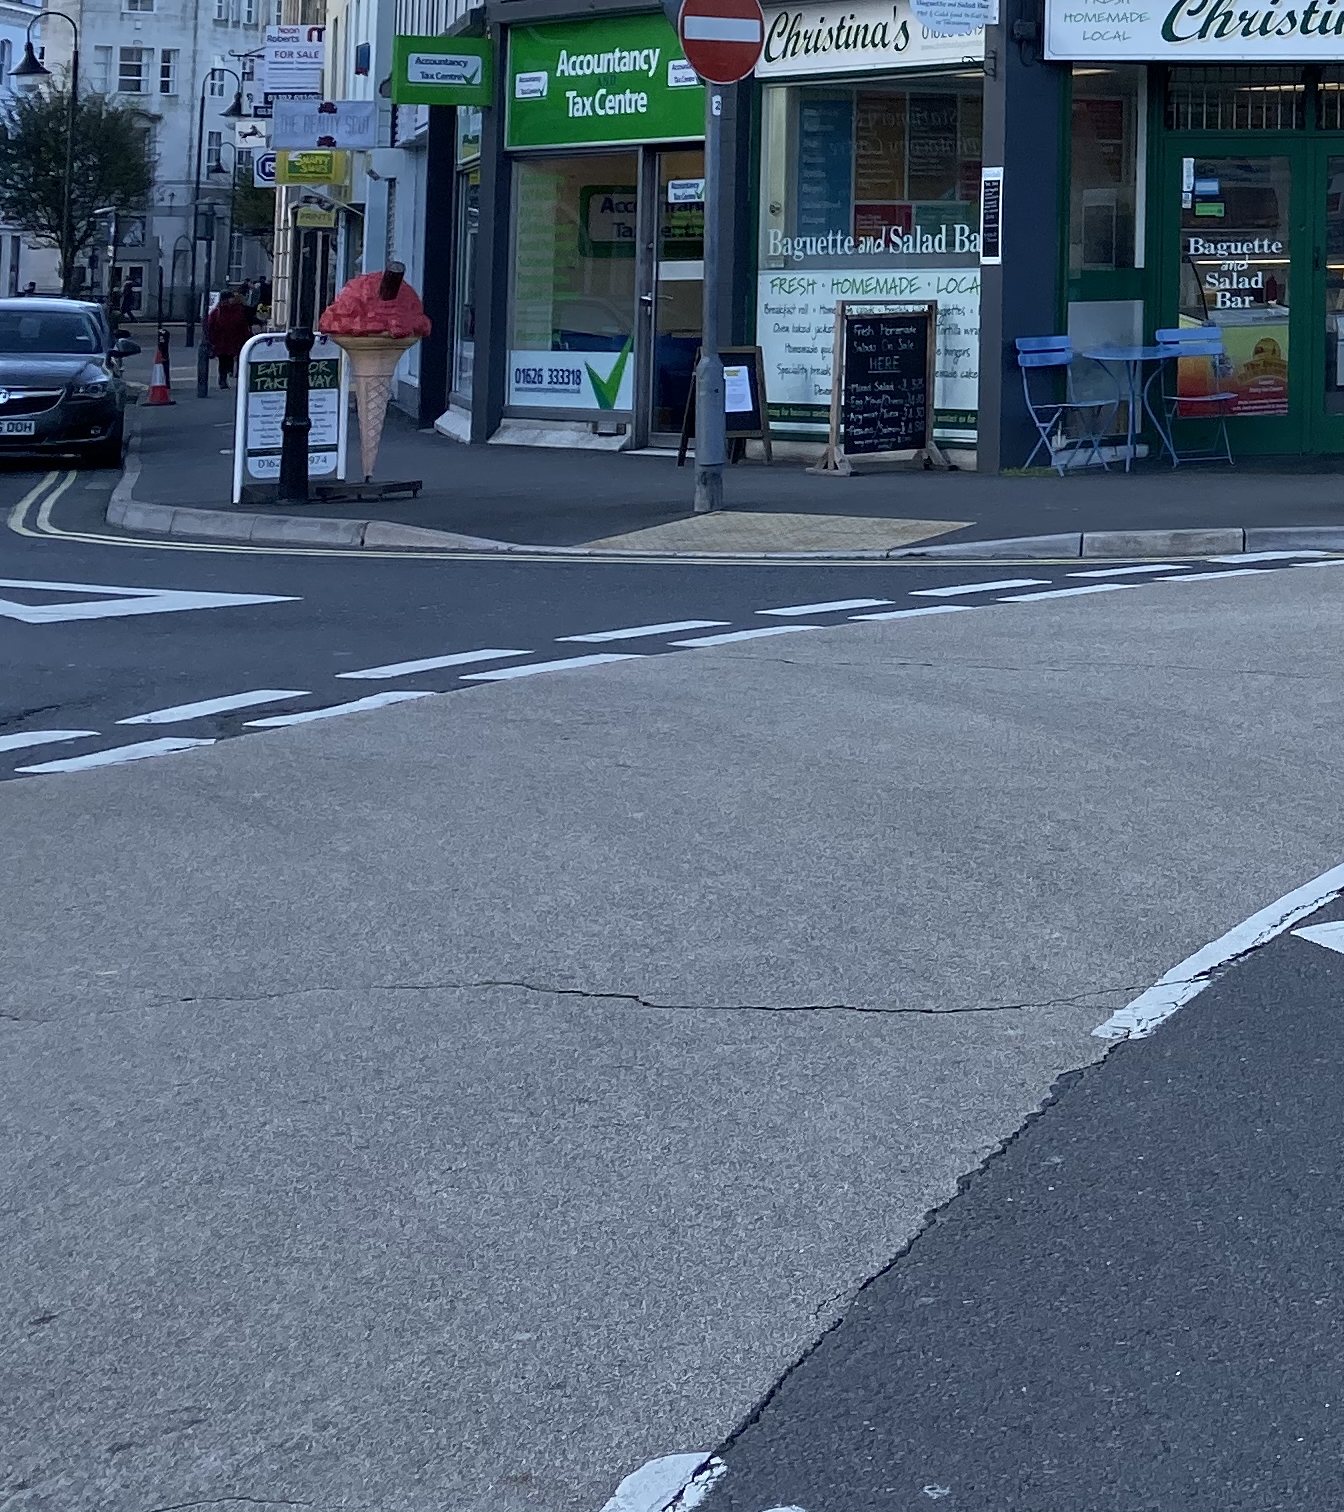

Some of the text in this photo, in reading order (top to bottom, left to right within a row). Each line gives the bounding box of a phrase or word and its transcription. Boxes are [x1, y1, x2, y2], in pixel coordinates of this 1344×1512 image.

[1064, 11, 1150, 24] HOMEMADE
[267, 35, 300, 43] Roberts
[764, 6, 910, 64] Christina's
[1082, 29, 1132, 41] LOCAL
[274, 50, 320, 59] FOR SALE
[415, 57, 468, 68] Accountancy
[556, 46, 660, 77] Accountancy
[420, 71, 463, 80] Tax Centre
[566, 88, 648, 117] Tax Centre
[768, 224, 981, 261] Baguette and Salad Ba
[1189, 237, 1283, 258] Baguette
[1221, 255, 1249, 271] and
[770, 276, 981, 296] FRESH HOMEMADE LOCA
[1205, 271, 1264, 289] Salad
[1216, 291, 1254, 308] Bar
[853, 324, 874, 337] Fresh
[257, 362, 288, 375] EAT
[869, 355, 900, 371] HERE
[515, 368, 582, 386] 01626 333318
